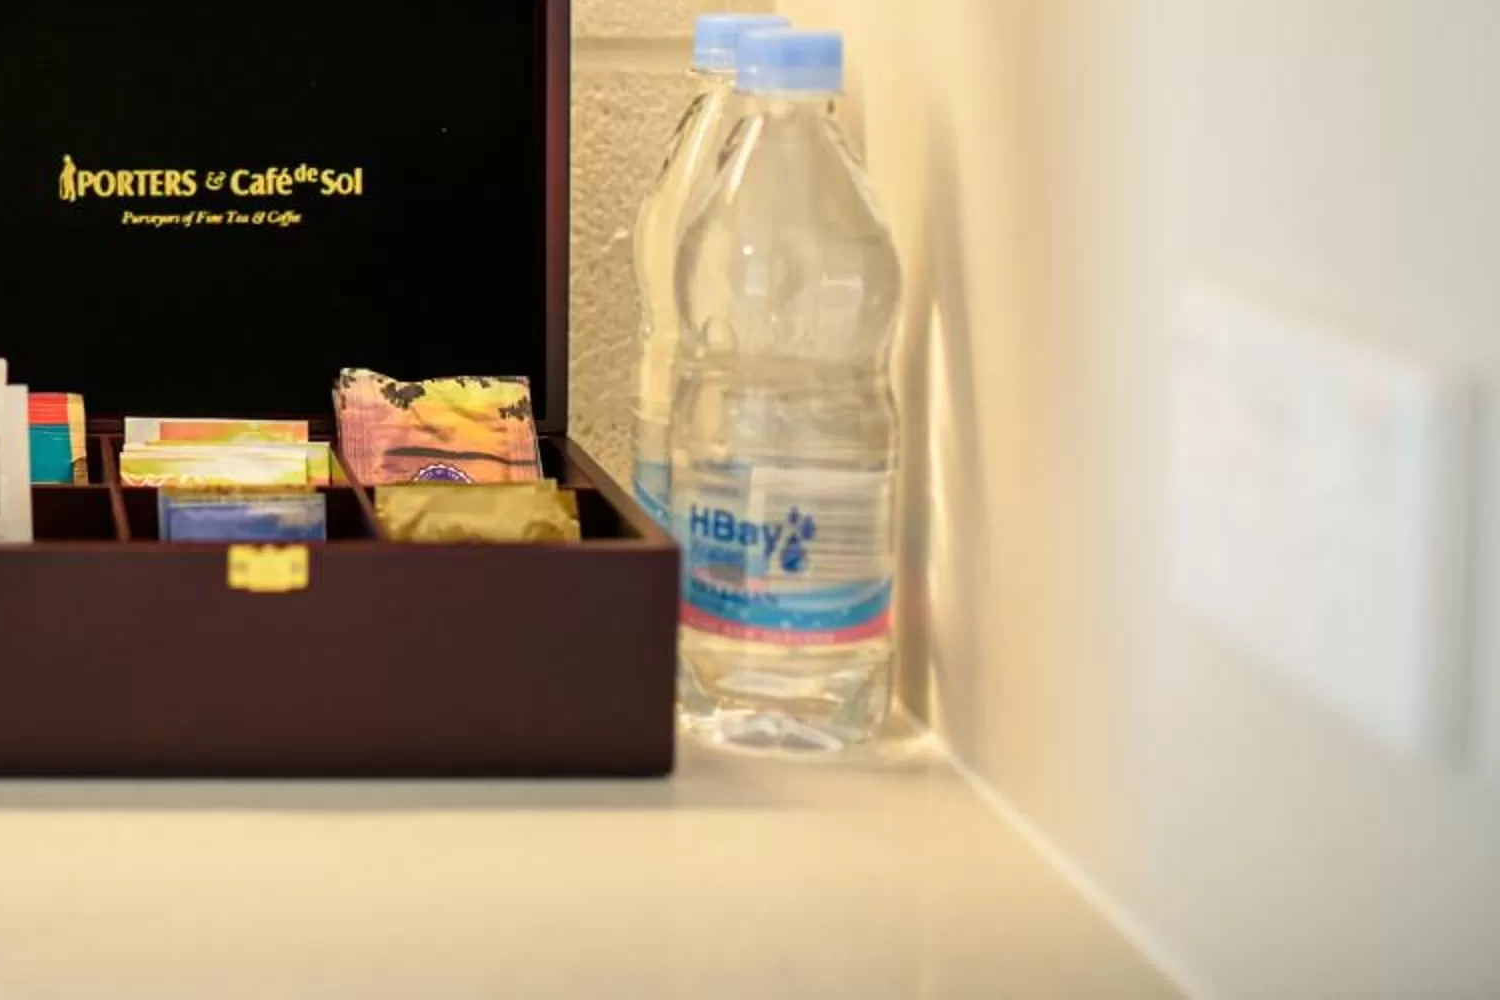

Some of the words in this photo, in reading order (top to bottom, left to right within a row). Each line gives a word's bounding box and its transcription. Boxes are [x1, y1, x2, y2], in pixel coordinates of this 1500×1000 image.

[78, 169, 197, 197] PORTERS
[205, 171, 226, 191] &
[230, 166, 293, 197] Café
[295, 163, 319, 183] de
[320, 168, 363, 195] Sol
